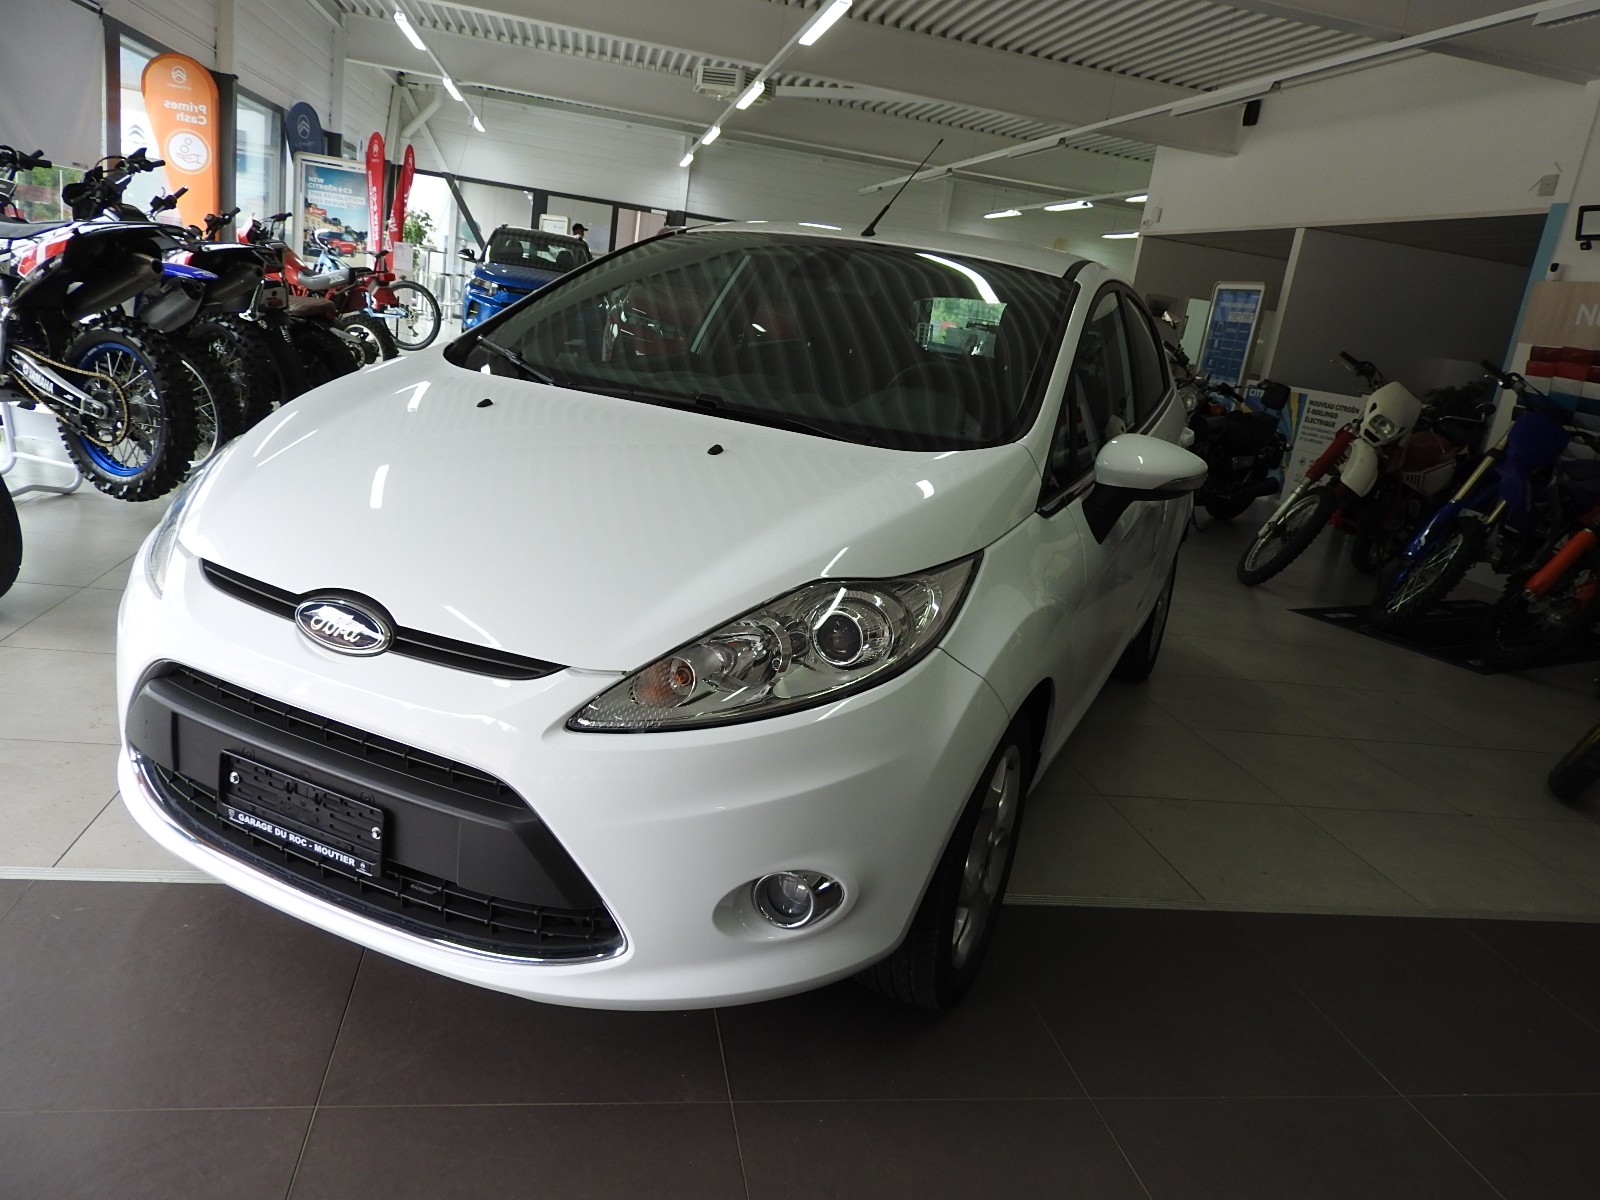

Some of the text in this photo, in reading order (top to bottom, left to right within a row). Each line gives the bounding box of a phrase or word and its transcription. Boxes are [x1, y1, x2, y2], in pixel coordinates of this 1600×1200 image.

[308, 176, 325, 184] NEW
[28, 367, 54, 394] YAMAHA
[1308, 400, 1360, 414] NOUVEAU CITROËN
[238, 813, 273, 834] GARAGE
[274, 827, 287, 839] DU
[288, 833, 308, 847] ROC
[314, 843, 355, 867] MOUTIER
